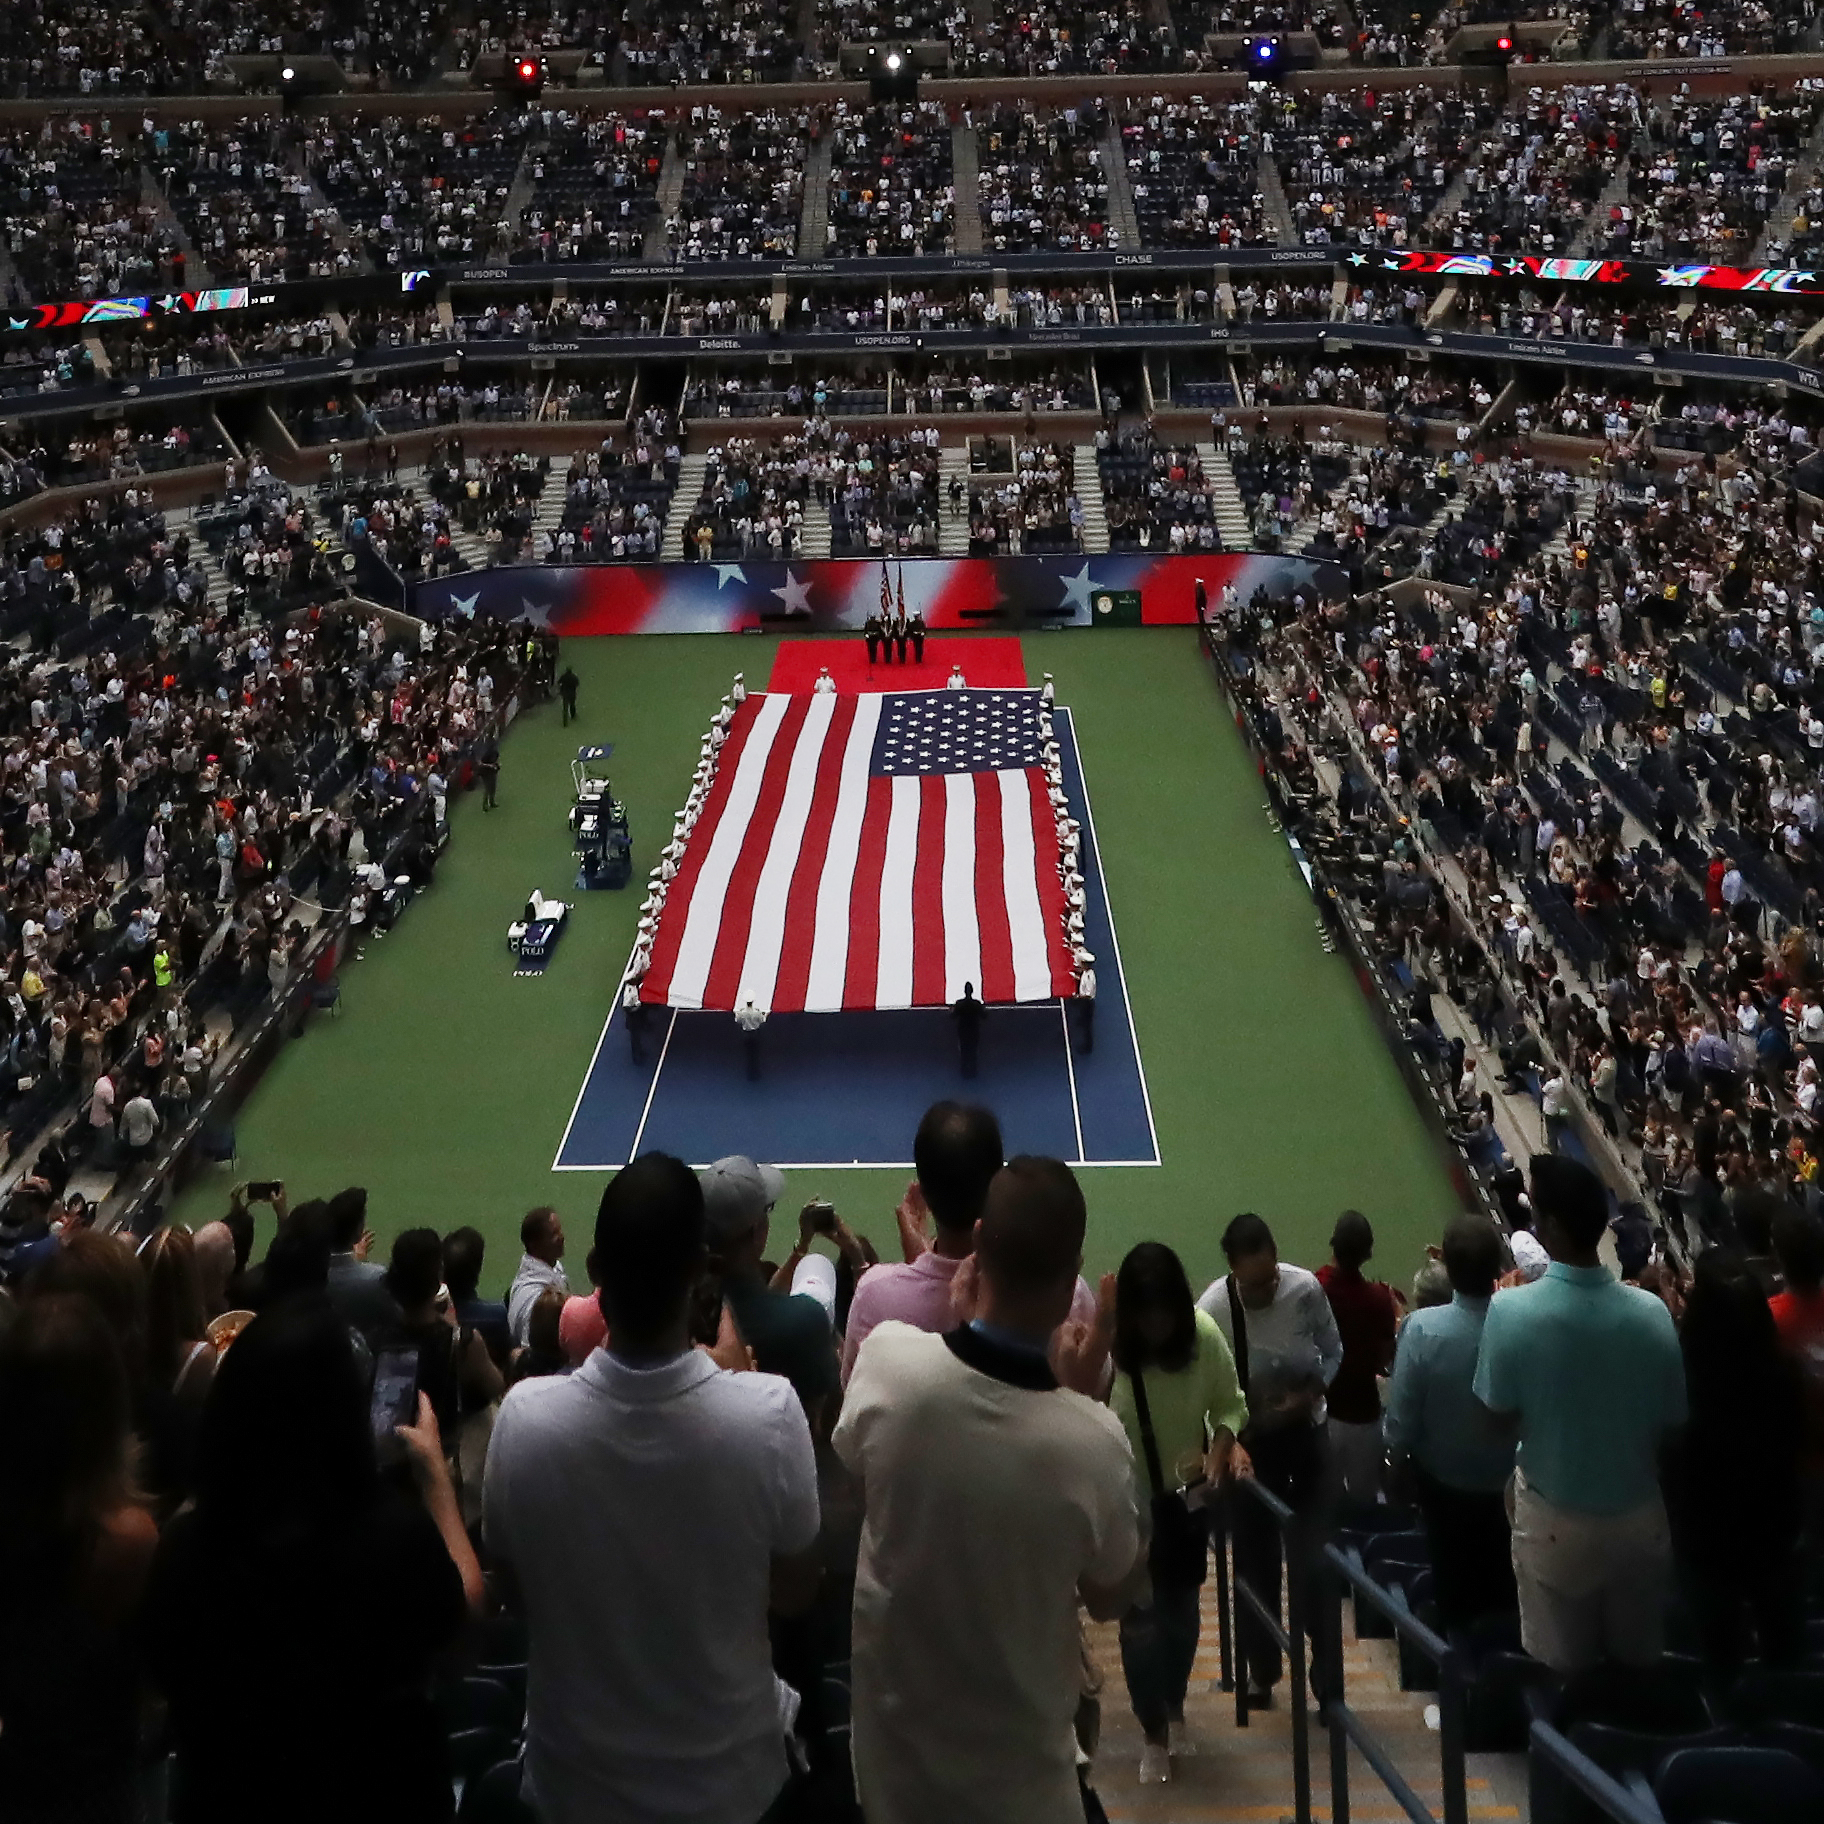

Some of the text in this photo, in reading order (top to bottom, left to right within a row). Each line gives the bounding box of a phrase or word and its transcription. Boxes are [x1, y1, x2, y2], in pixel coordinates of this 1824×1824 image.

[1114, 254, 1153, 265] CHASE
[1271, 251, 1327, 262] USOPEN.ORG
[1209, 328, 1230, 339] IHG
[854, 335, 911, 346] USOPEN.ORG
[527, 342, 576, 354] Spectrum
[521, 945, 545, 956] POLO
